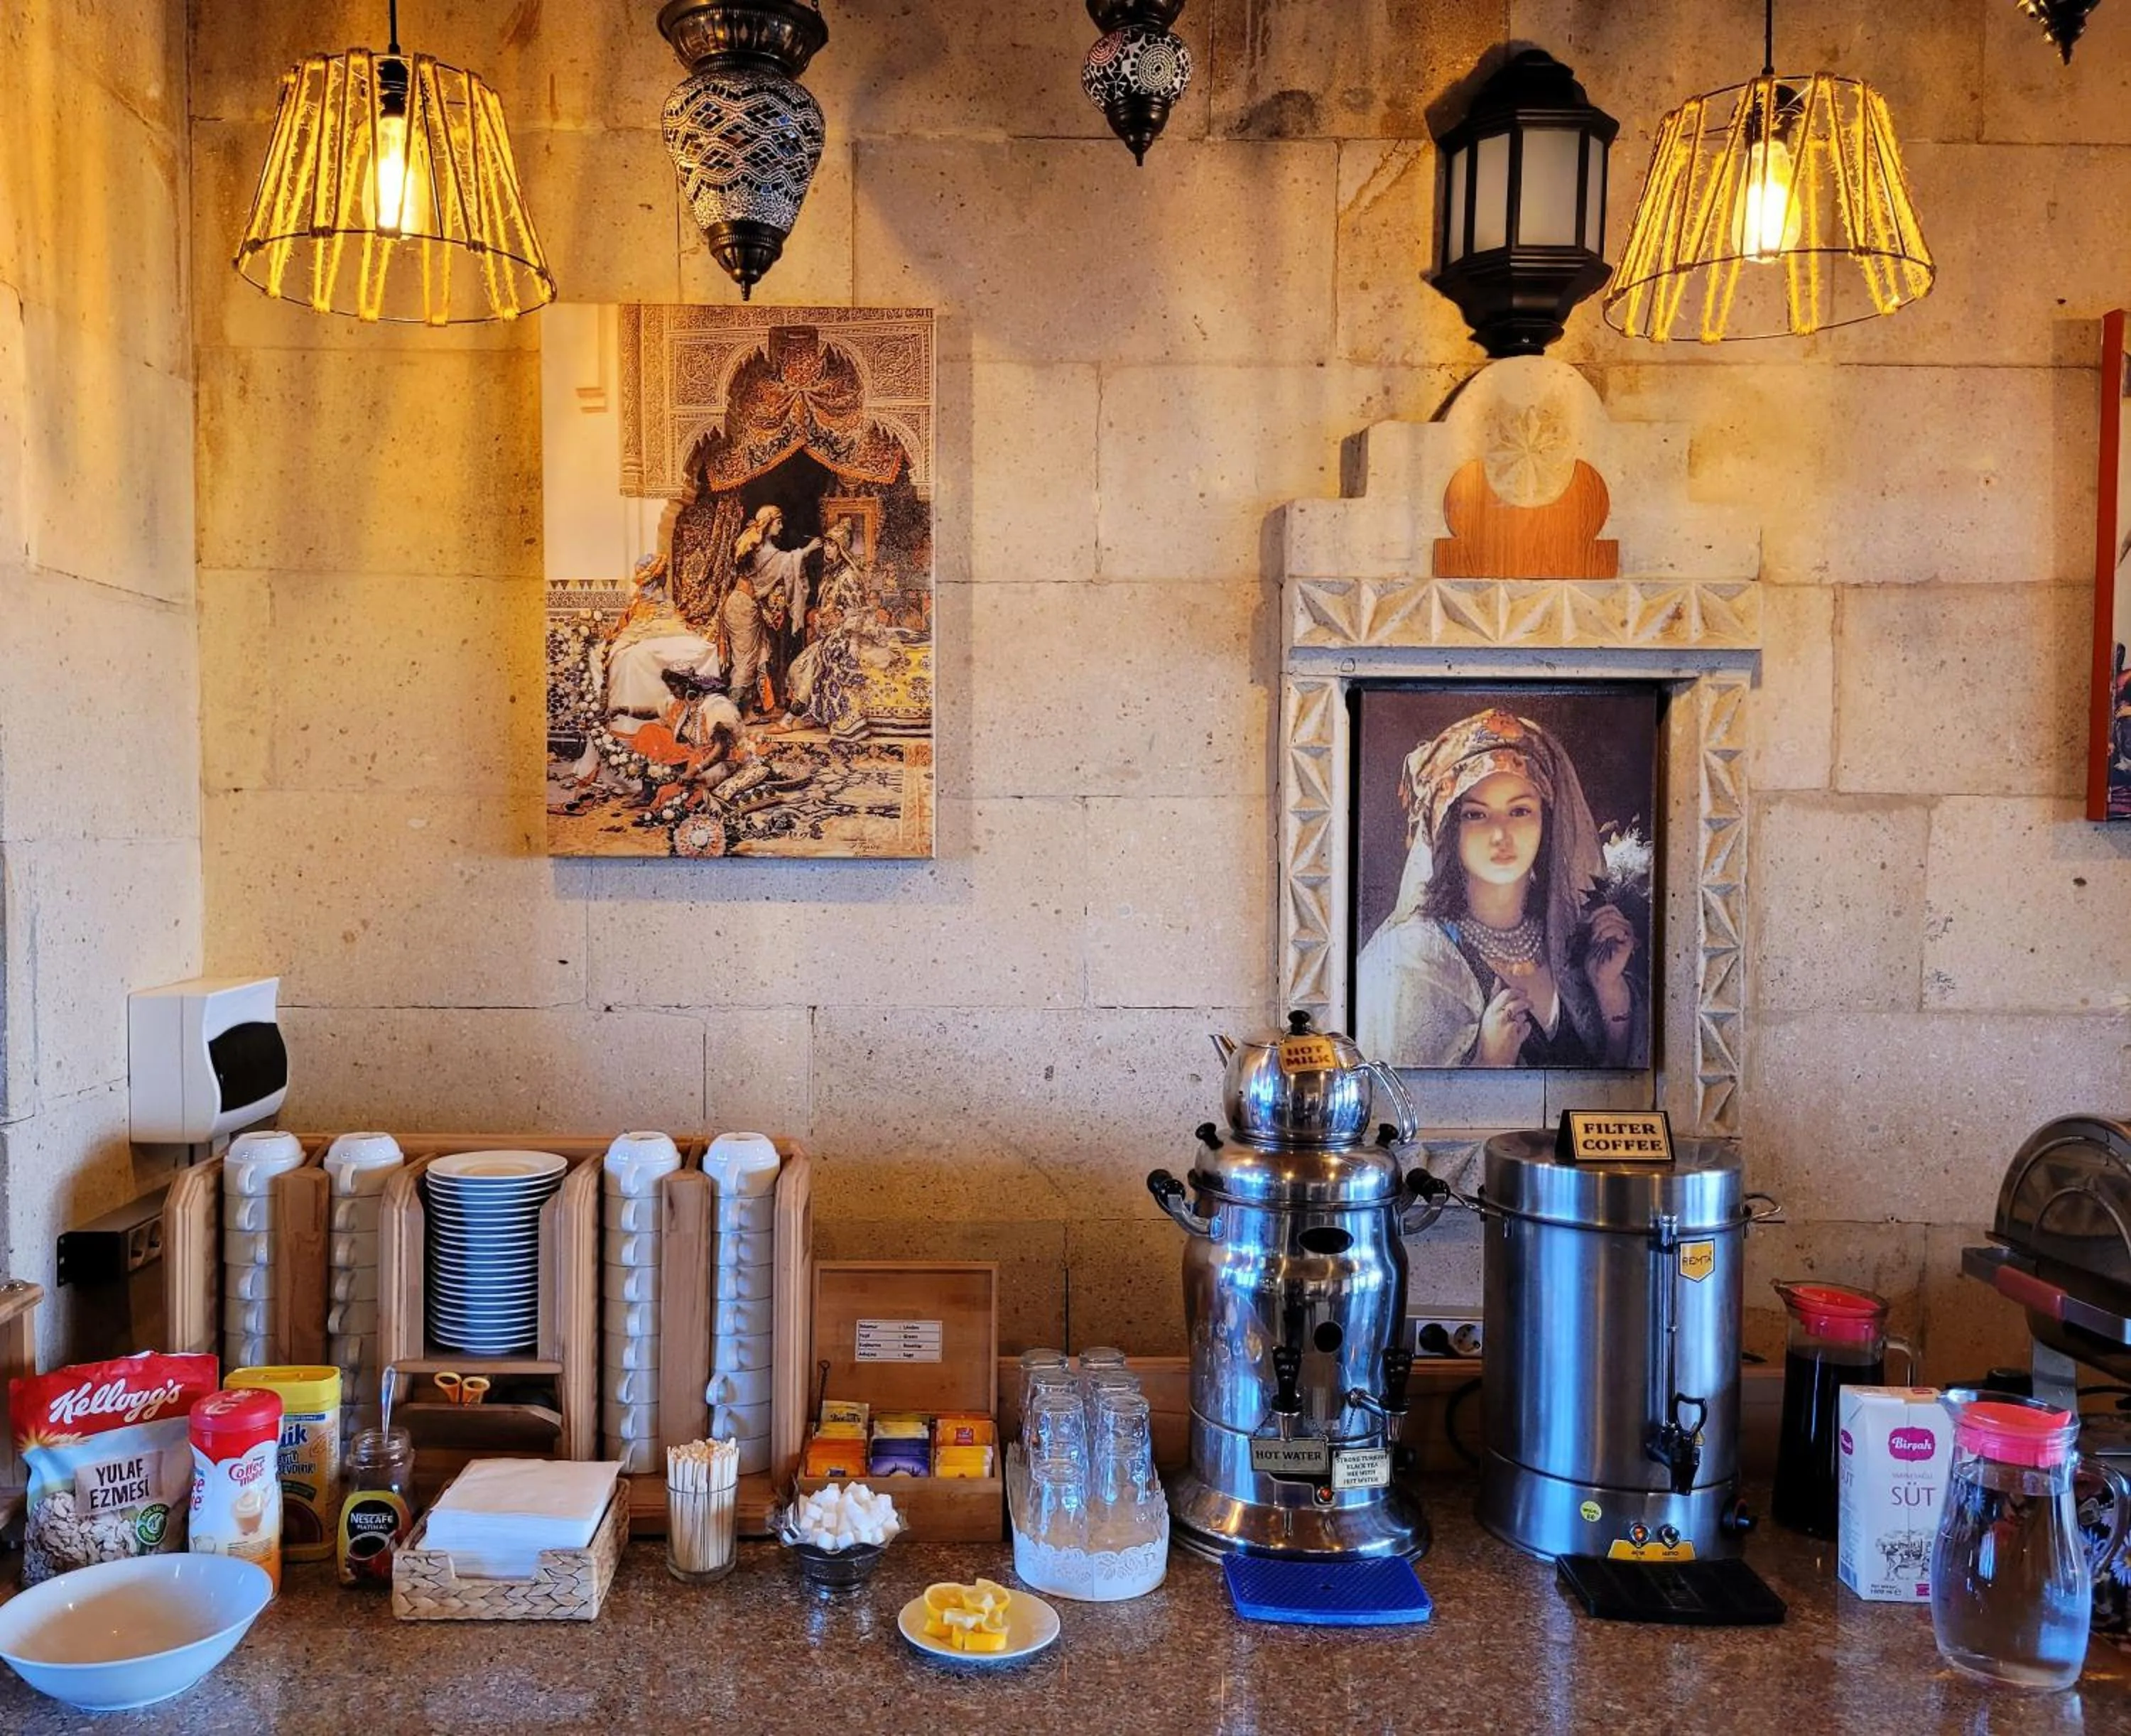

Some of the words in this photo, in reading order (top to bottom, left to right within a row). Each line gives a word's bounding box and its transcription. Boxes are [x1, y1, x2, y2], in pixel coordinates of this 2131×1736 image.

[1287, 1045, 1323, 1056] HOT
[1286, 1054, 1330, 1066] MILK
[1583, 1123, 1656, 1134] FILTER
[1582, 1139, 1663, 1151] COFFEE
[48, 1378, 185, 1424] Kellogg's
[1892, 1436, 1932, 1451] Birşah
[1255, 1451, 1279, 1460] HOT
[1283, 1450, 1322, 1460] WATER
[96, 1458, 143, 1486] YULAF
[228, 1459, 265, 1481] Coffee
[90, 1475, 150, 1509] EZMESİ
[1892, 1482, 1936, 1507] SÜT
